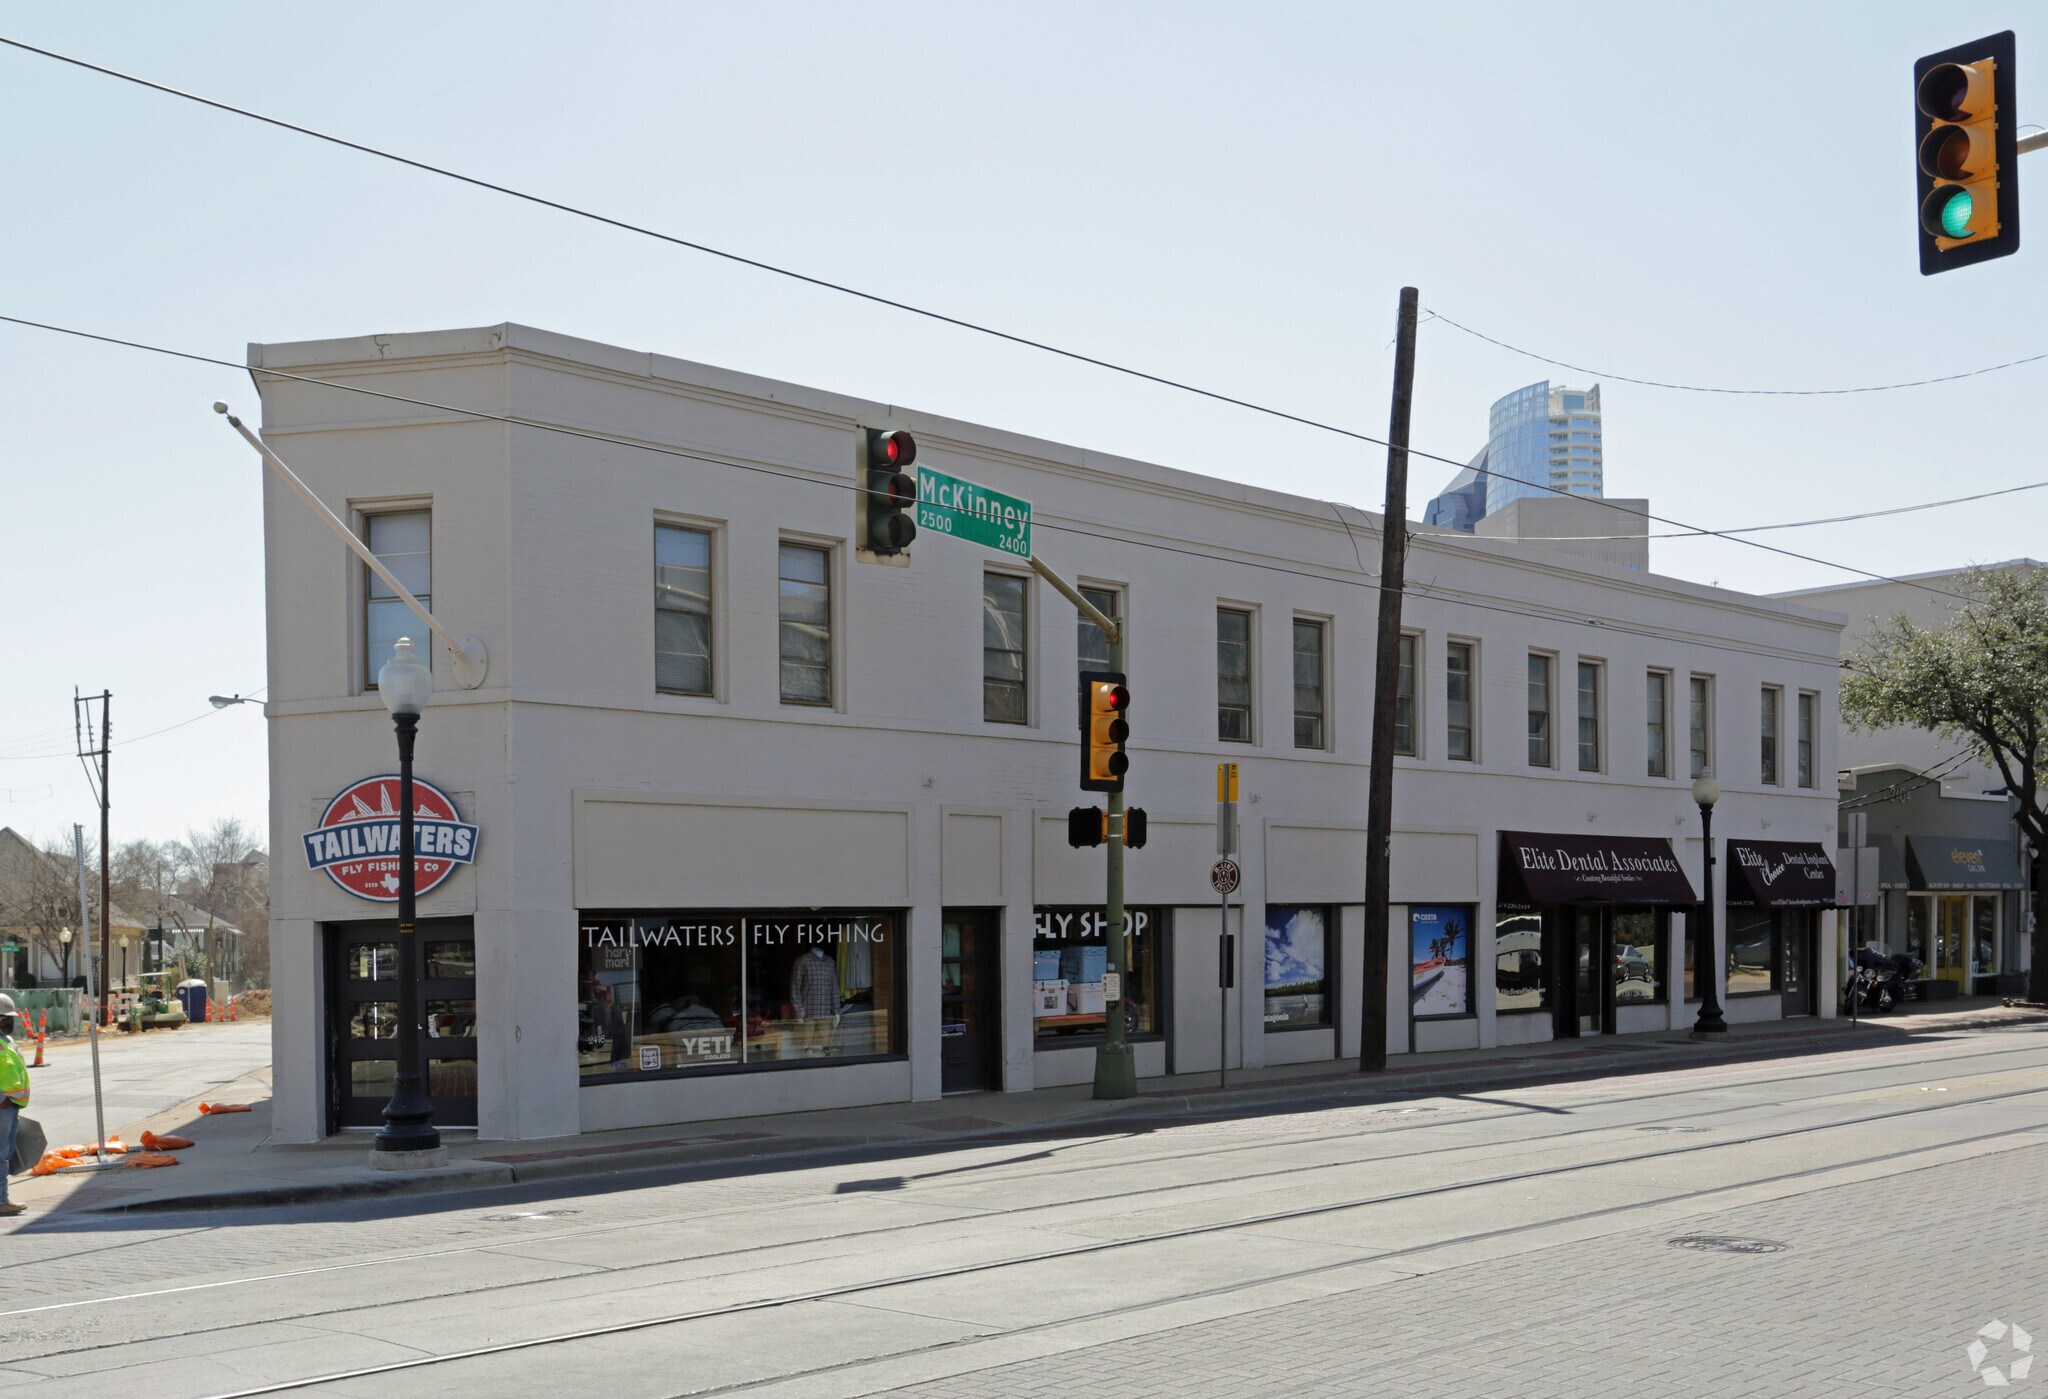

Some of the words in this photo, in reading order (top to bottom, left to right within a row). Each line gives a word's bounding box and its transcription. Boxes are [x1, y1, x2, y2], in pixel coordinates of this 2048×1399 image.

[920, 472, 1028, 540] McKinney
[921, 510, 952, 532] 2500
[1000, 534, 1027, 555] 2400
[341, 864, 363, 876] FLY
[368, 861, 419, 871] FISHIG
[1519, 846, 1557, 871] Elite
[1556, 848, 1609, 871] Dental
[1611, 850, 1678, 873] Associates
[1736, 847, 1765, 867] Elite
[1760, 859, 1786, 886] Choice
[1782, 852, 1806, 865] Dental
[1420, 913, 1438, 921] COSTA
[582, 925, 735, 948] TAILWATERS
[753, 924, 790, 945] FLY
[797, 923, 884, 944] FISHING
[681, 1035, 732, 1056] YETI
